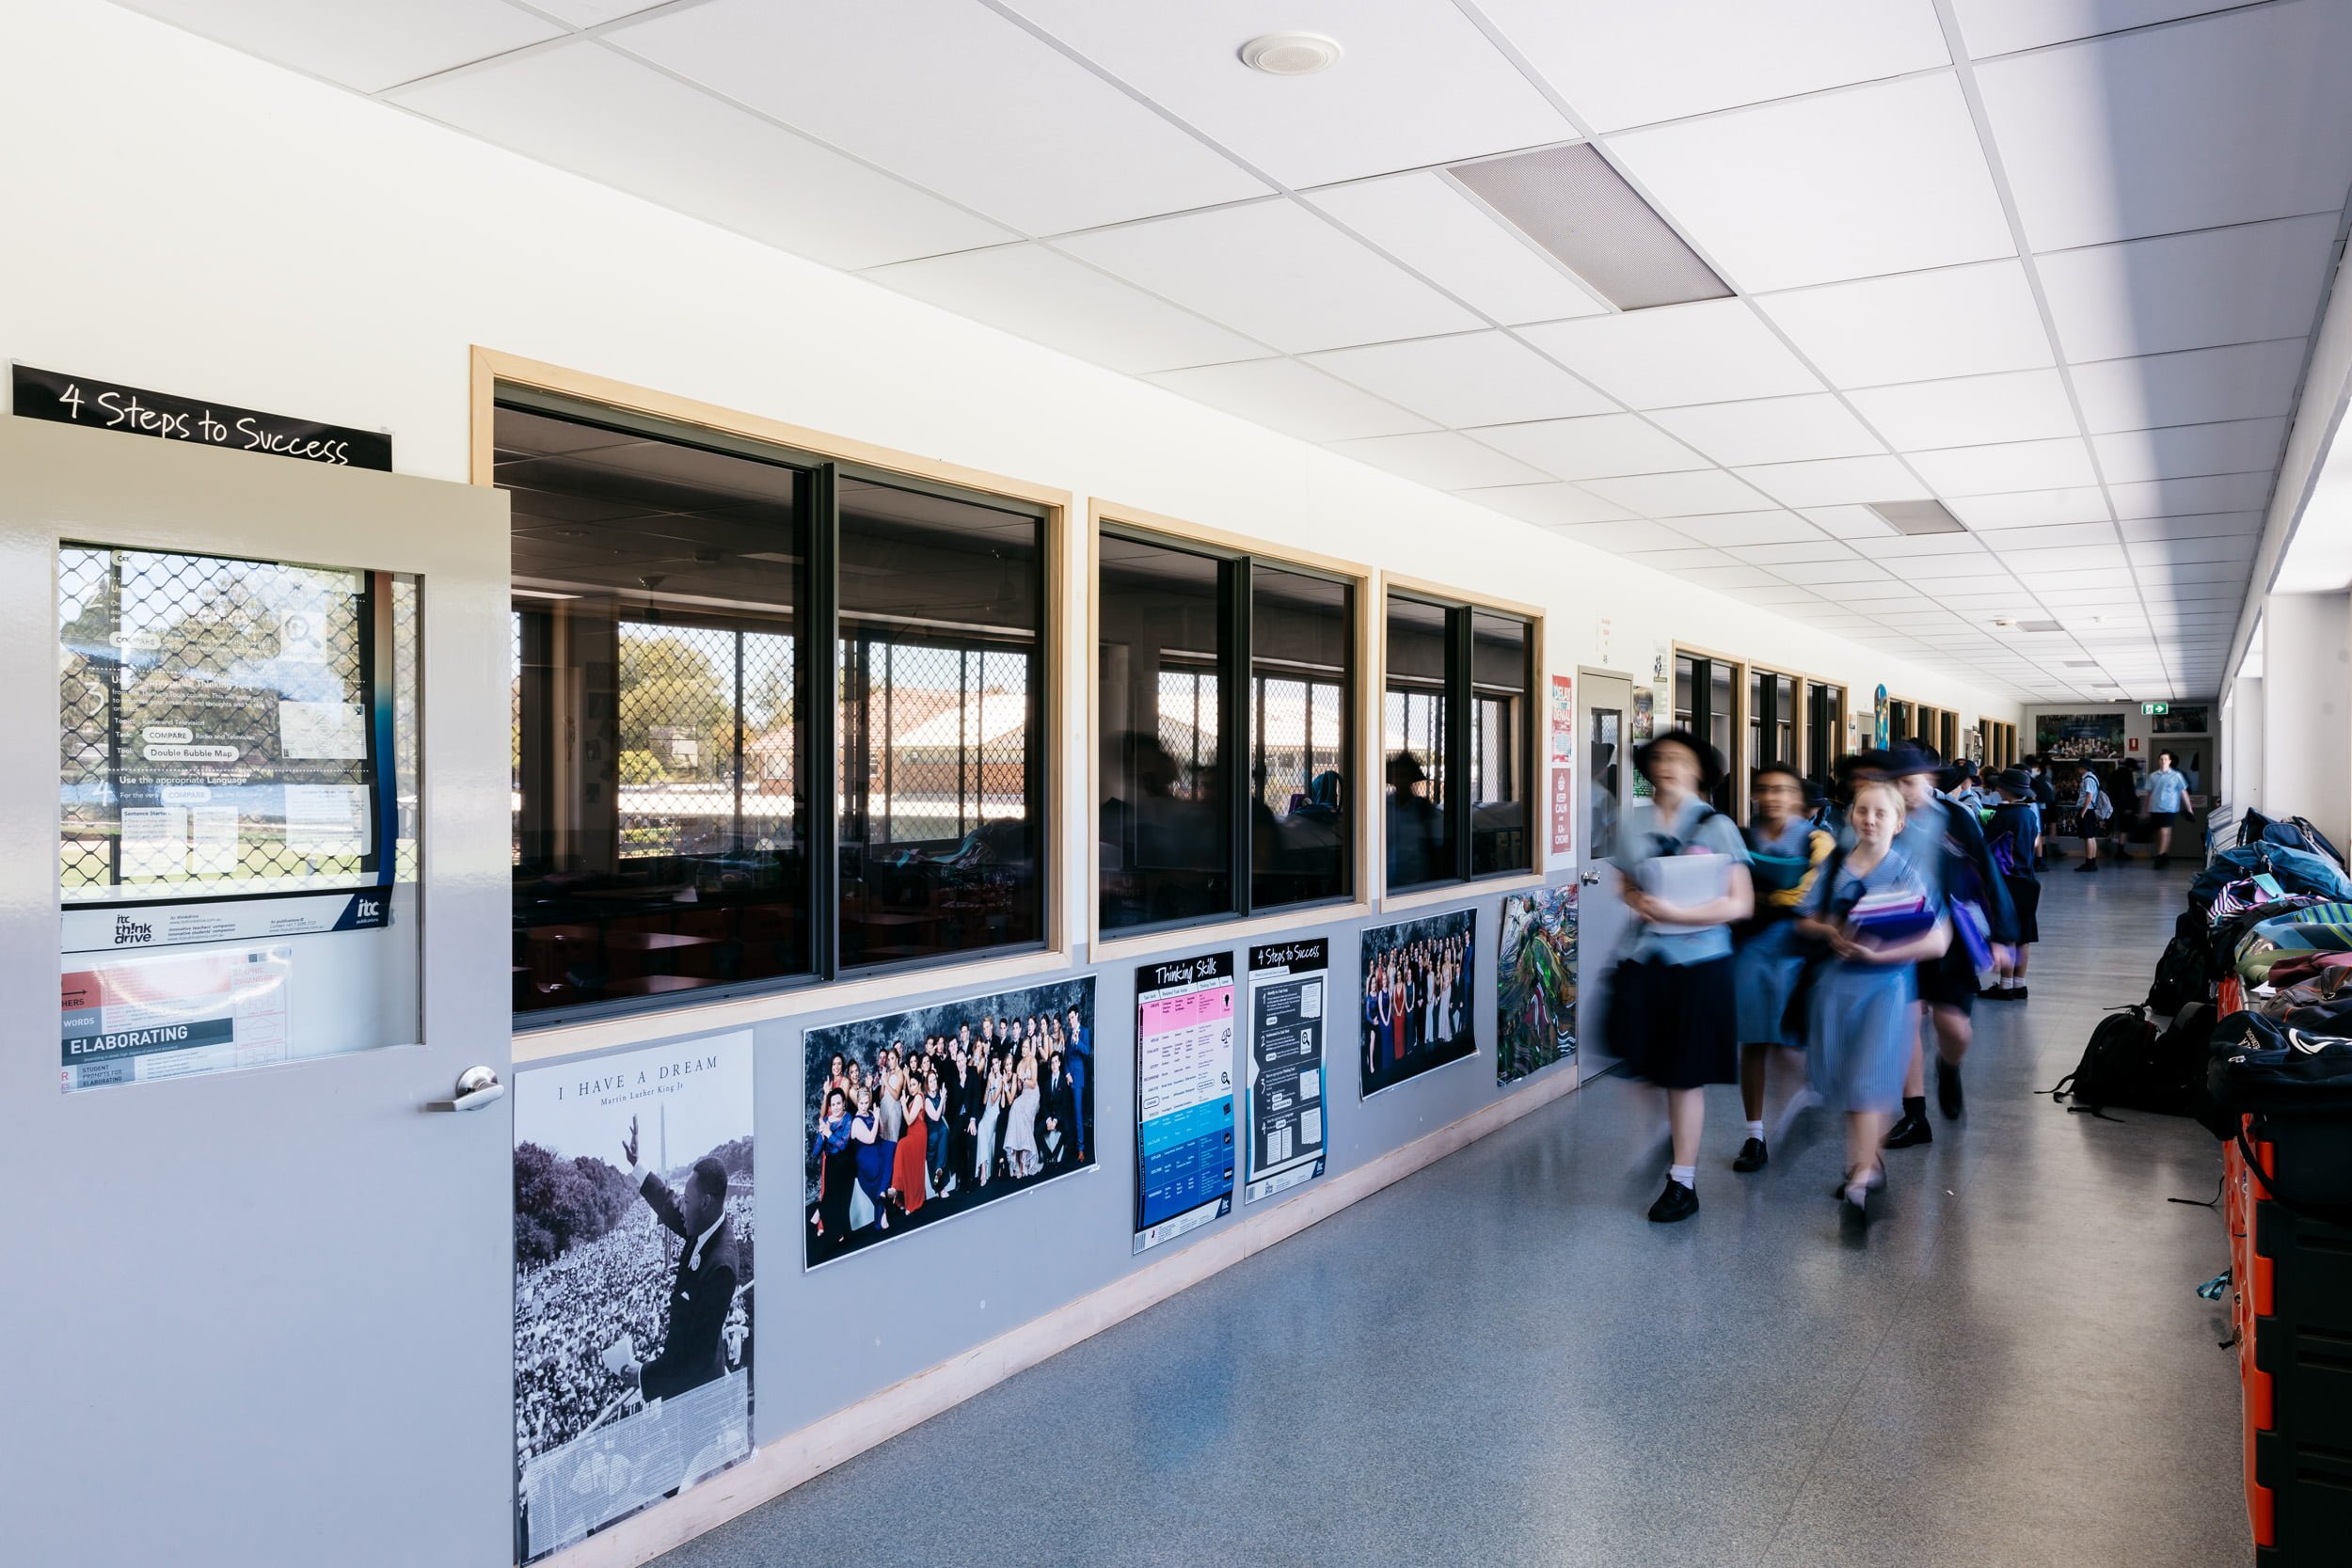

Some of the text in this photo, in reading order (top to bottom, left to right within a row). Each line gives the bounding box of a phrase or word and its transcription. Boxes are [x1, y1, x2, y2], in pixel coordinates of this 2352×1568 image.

[59, 384, 349, 466] 4 Steps to Success
[196, 679, 232, 690] Thinking
[86, 681, 105, 716] 3
[151, 749, 182, 757] Double
[215, 750, 233, 758] Map
[119, 776, 247, 785] Use the appropriate Language
[92, 779, 114, 807] 4
[1556, 793, 1566, 802] KEEP
[1555, 803, 1567, 814] CALM
[357, 898, 379, 917] itc
[117, 914, 130, 923] itc
[114, 932, 152, 944] drive
[1258, 944, 1320, 967] 4 Steps to Success
[1155, 958, 1217, 985] Thinking Skills
[1262, 992, 1266, 1005] 1
[63, 1017, 95, 1028] WORDS
[70, 1025, 188, 1055] ELABORATING
[1261, 1036, 1265, 1048] 2
[83, 1065, 109, 1073] STUDENT
[83, 1071, 110, 1080] PROMPTS
[83, 1075, 122, 1087] ELABORATING
[559, 1055, 718, 1101] I HAVE A DREAM
[1261, 1078, 1266, 1095] 3
[600, 1094, 627, 1106] Martin
[629, 1088, 656, 1100] Luther
[658, 1085, 675, 1094] King
[1261, 1121, 1266, 1135] 4
